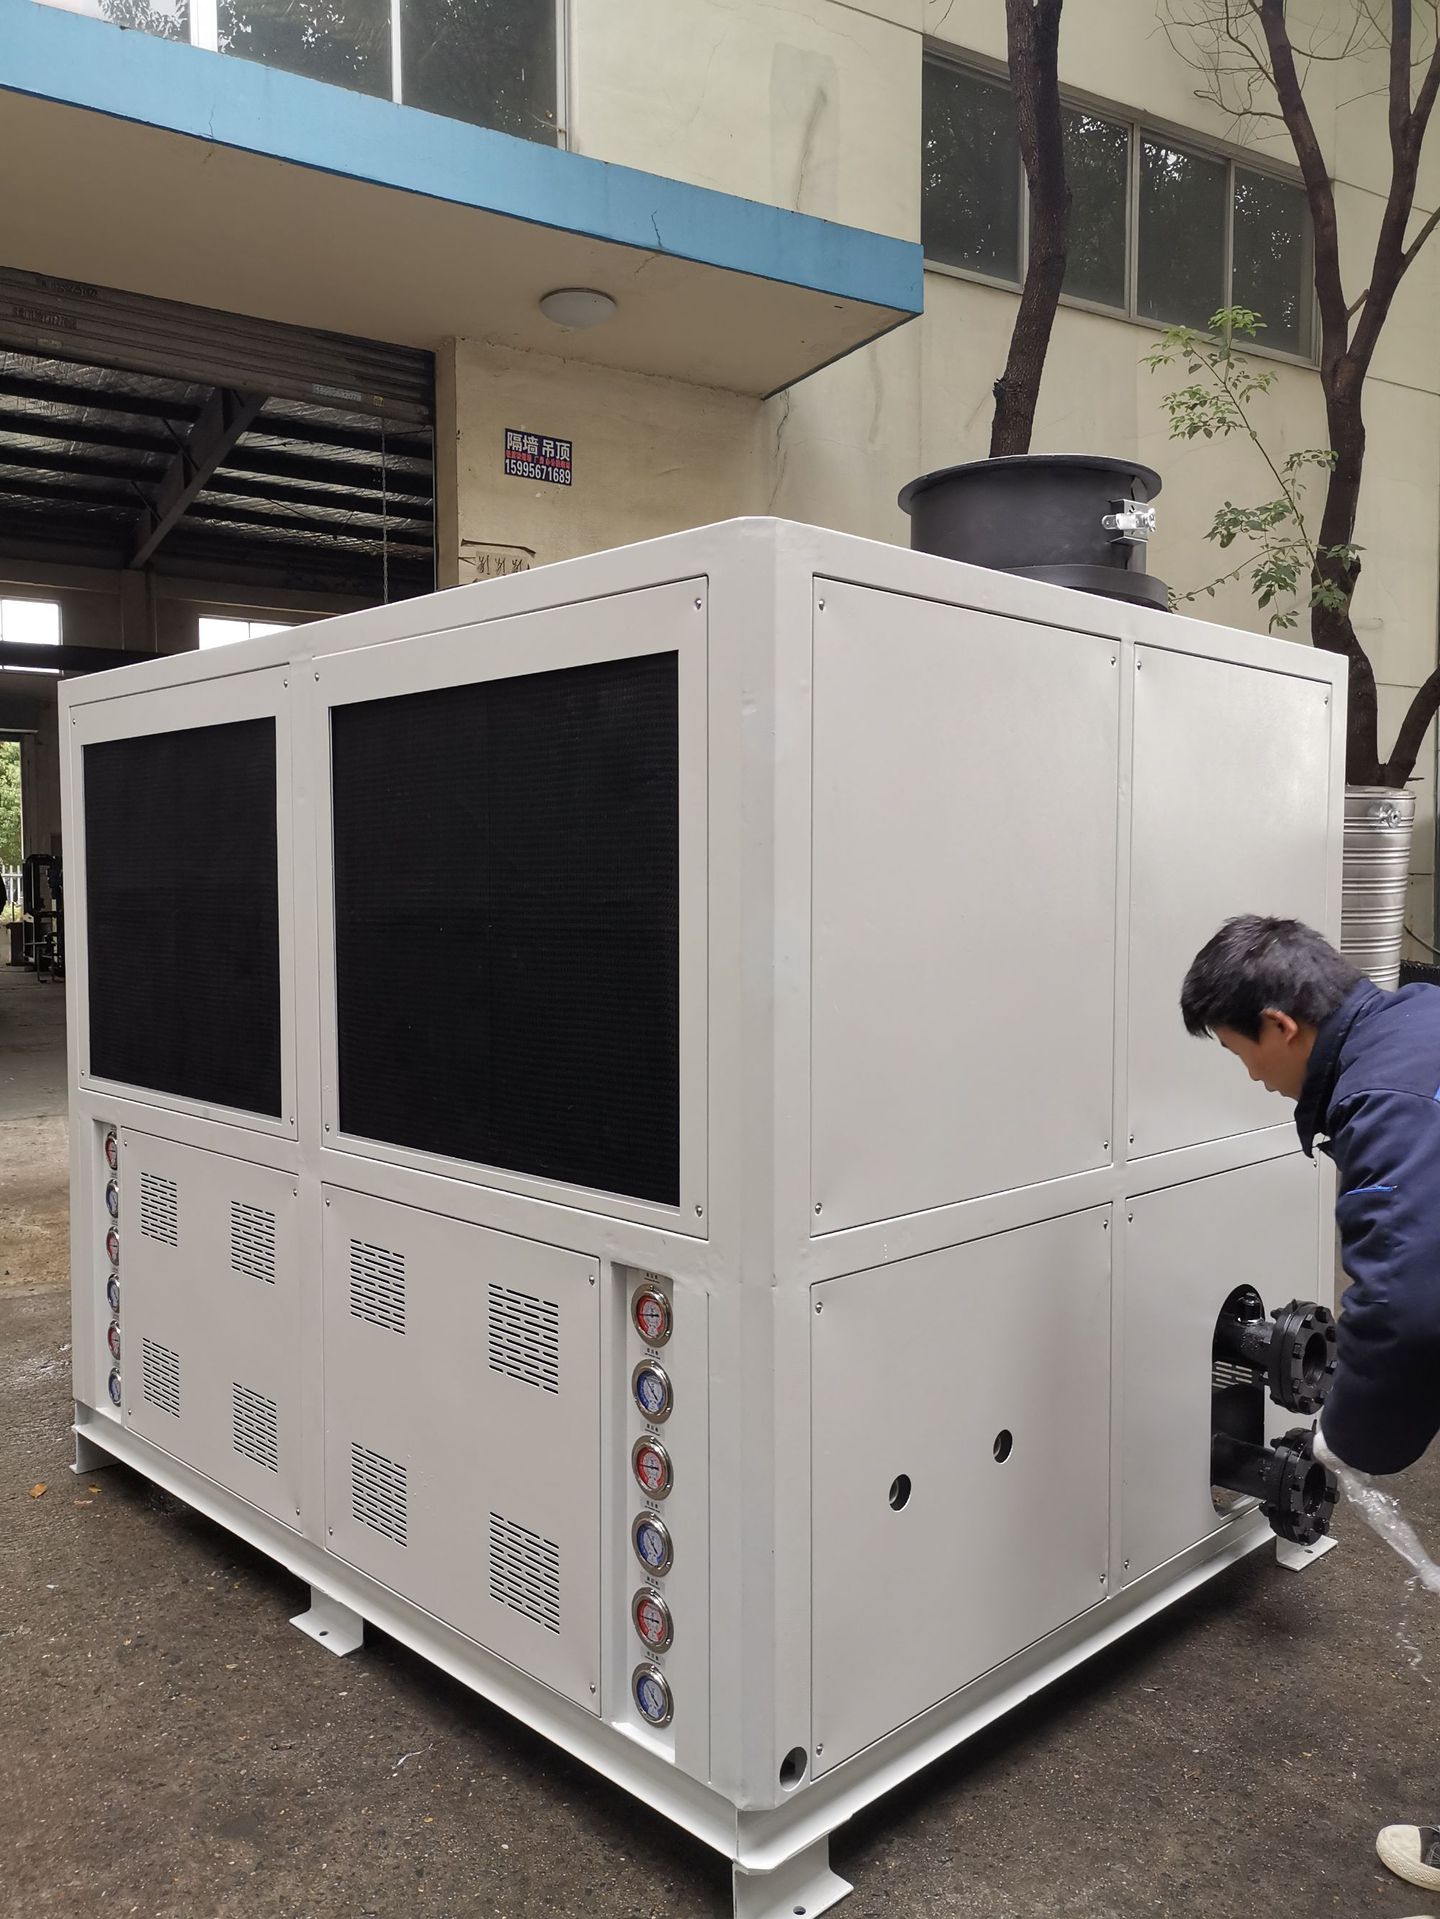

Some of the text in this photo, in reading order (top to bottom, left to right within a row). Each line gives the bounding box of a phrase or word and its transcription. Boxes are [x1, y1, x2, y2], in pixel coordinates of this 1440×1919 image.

[507, 431, 539, 455] 隔墙
[542, 439, 571, 461] 吊顶
[505, 458, 571, 485] 15995671689
